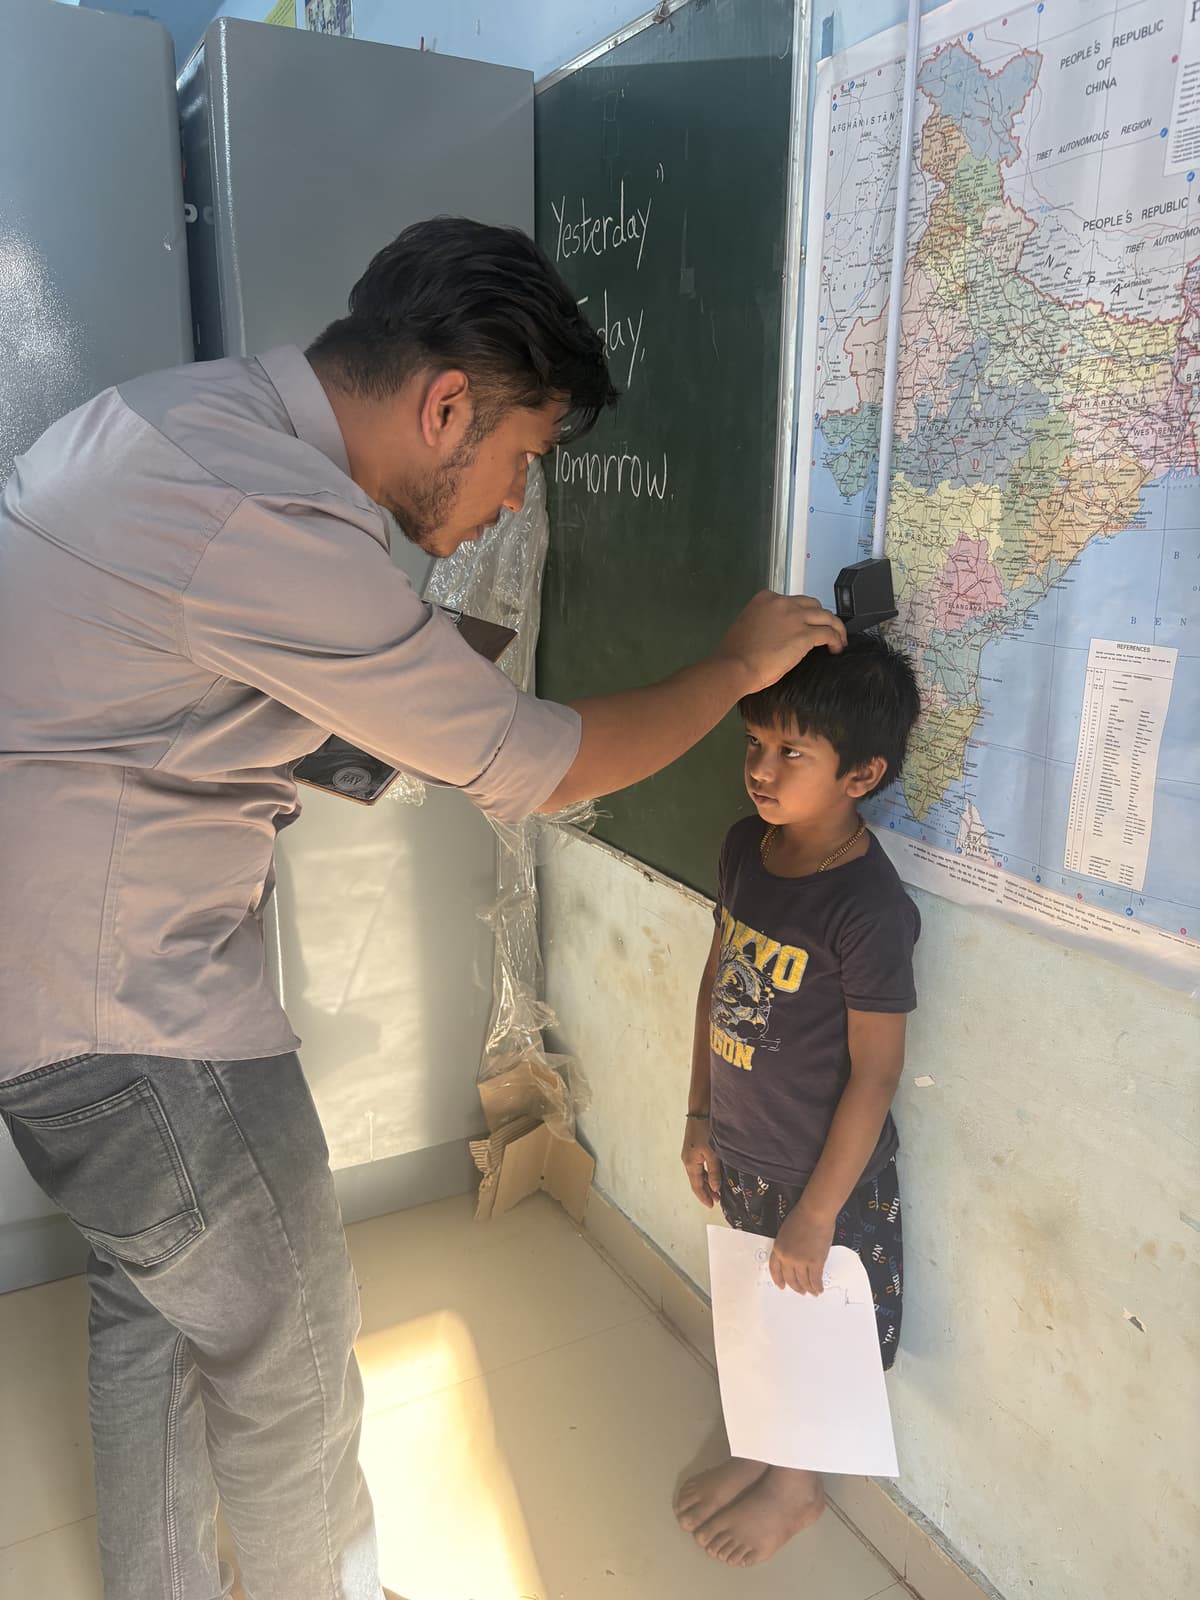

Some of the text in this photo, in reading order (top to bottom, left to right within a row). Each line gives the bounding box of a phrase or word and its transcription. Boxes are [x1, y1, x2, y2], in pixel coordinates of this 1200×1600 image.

[1060, 20, 1164, 70] PEOPLE'S REPUBLIC
[1096, 57, 1112, 71] OF
[1085, 77, 1118, 96] CHINA
[1036, 117, 1153, 161] TIBET AUTONOMOUS REGION
[551, 179, 652, 271] Yesterday
[1082, 209, 1133, 233] PEOPLE'S
[1141, 196, 1189, 221] REPUBLIC
[1125, 226, 1200, 255] TIBET AUTONOMO
[576, 288, 646, 389] day,
[1117, 643, 1151, 653] REFERENCES
